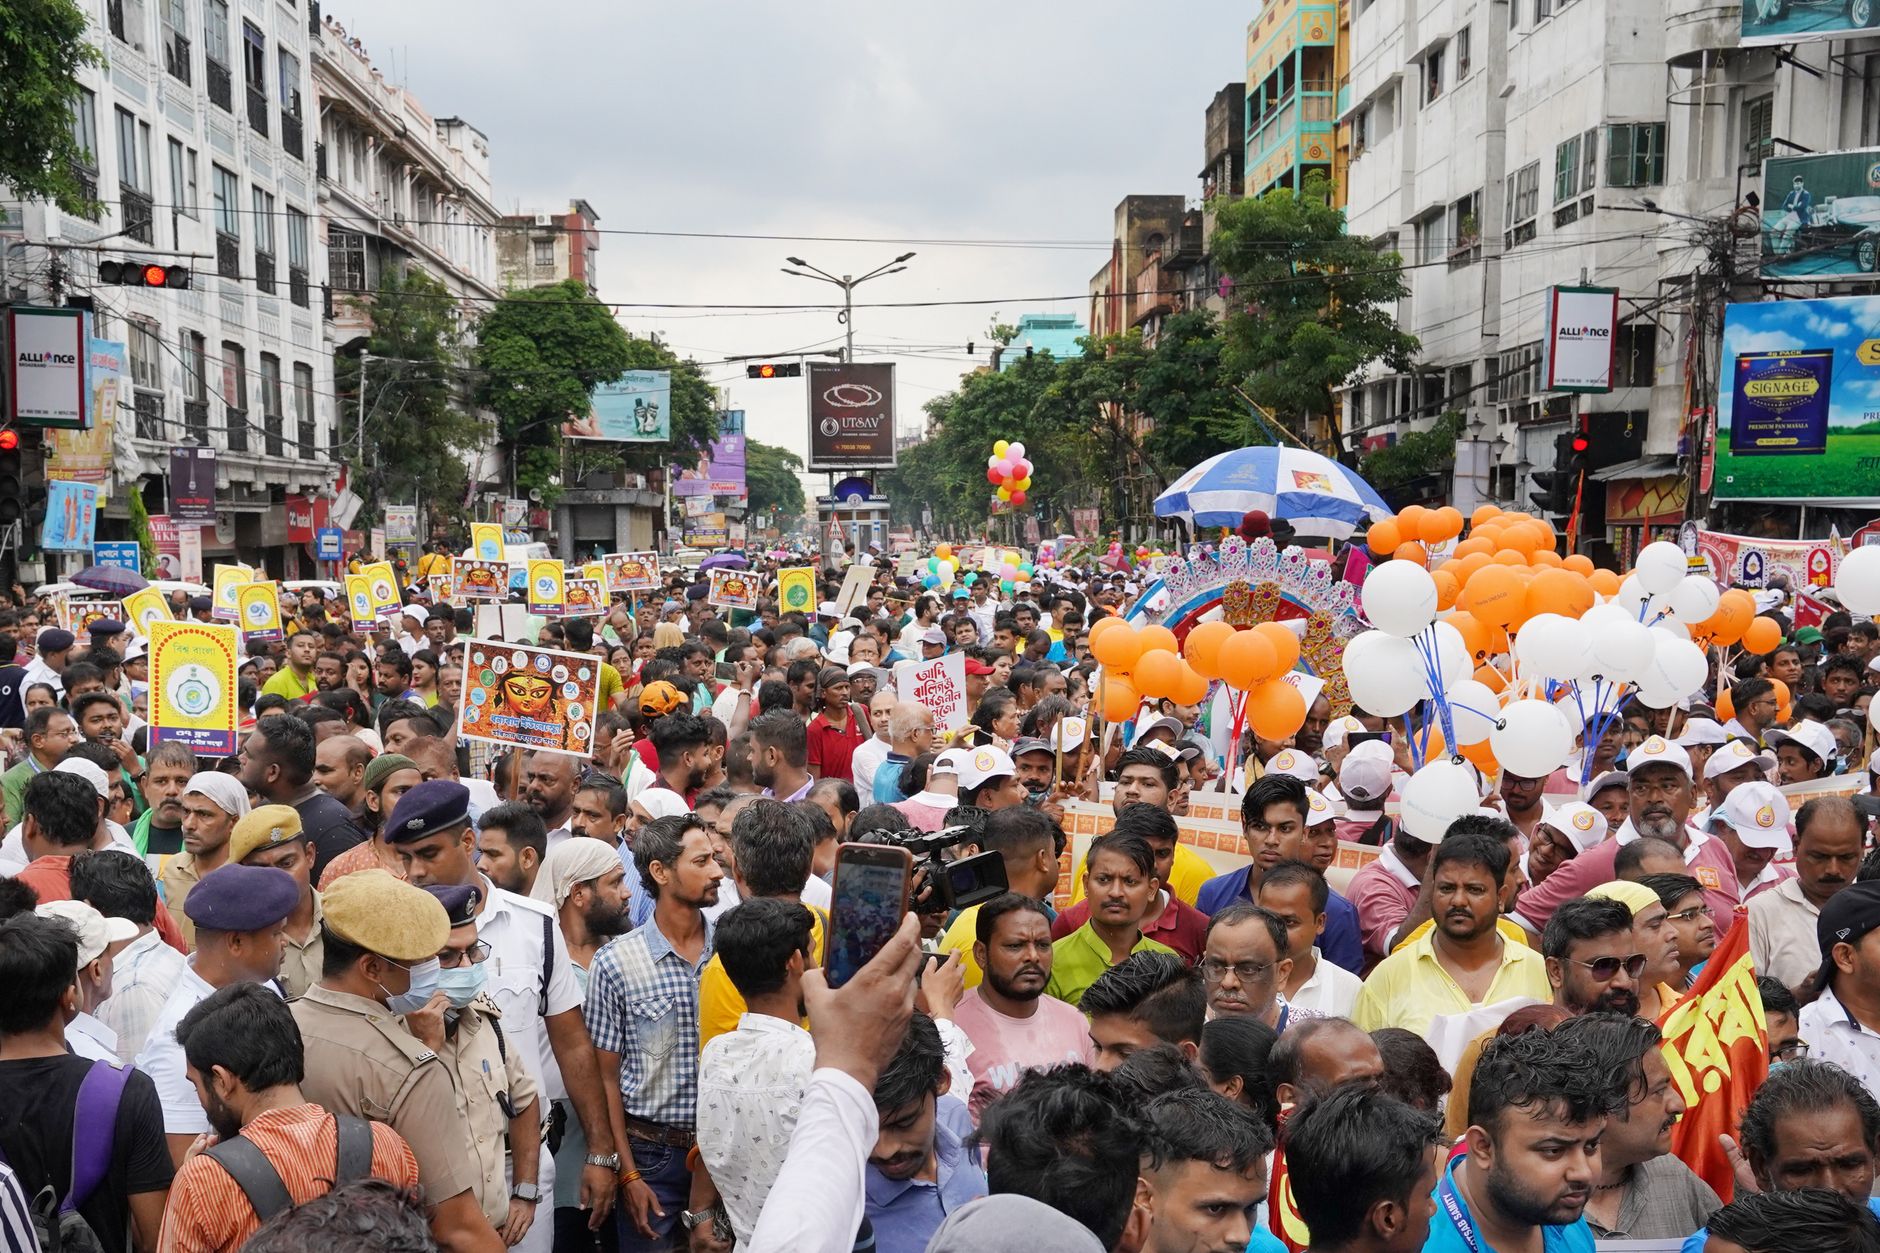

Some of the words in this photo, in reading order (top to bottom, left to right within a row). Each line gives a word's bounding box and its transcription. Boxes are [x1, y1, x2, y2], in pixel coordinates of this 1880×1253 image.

[1751, 381, 1810, 394] SIGNAGE
[842, 417, 879, 428] UTSAV
[915, 661, 947, 681] আদি
[1442, 1193, 1463, 1221] SAMITY
